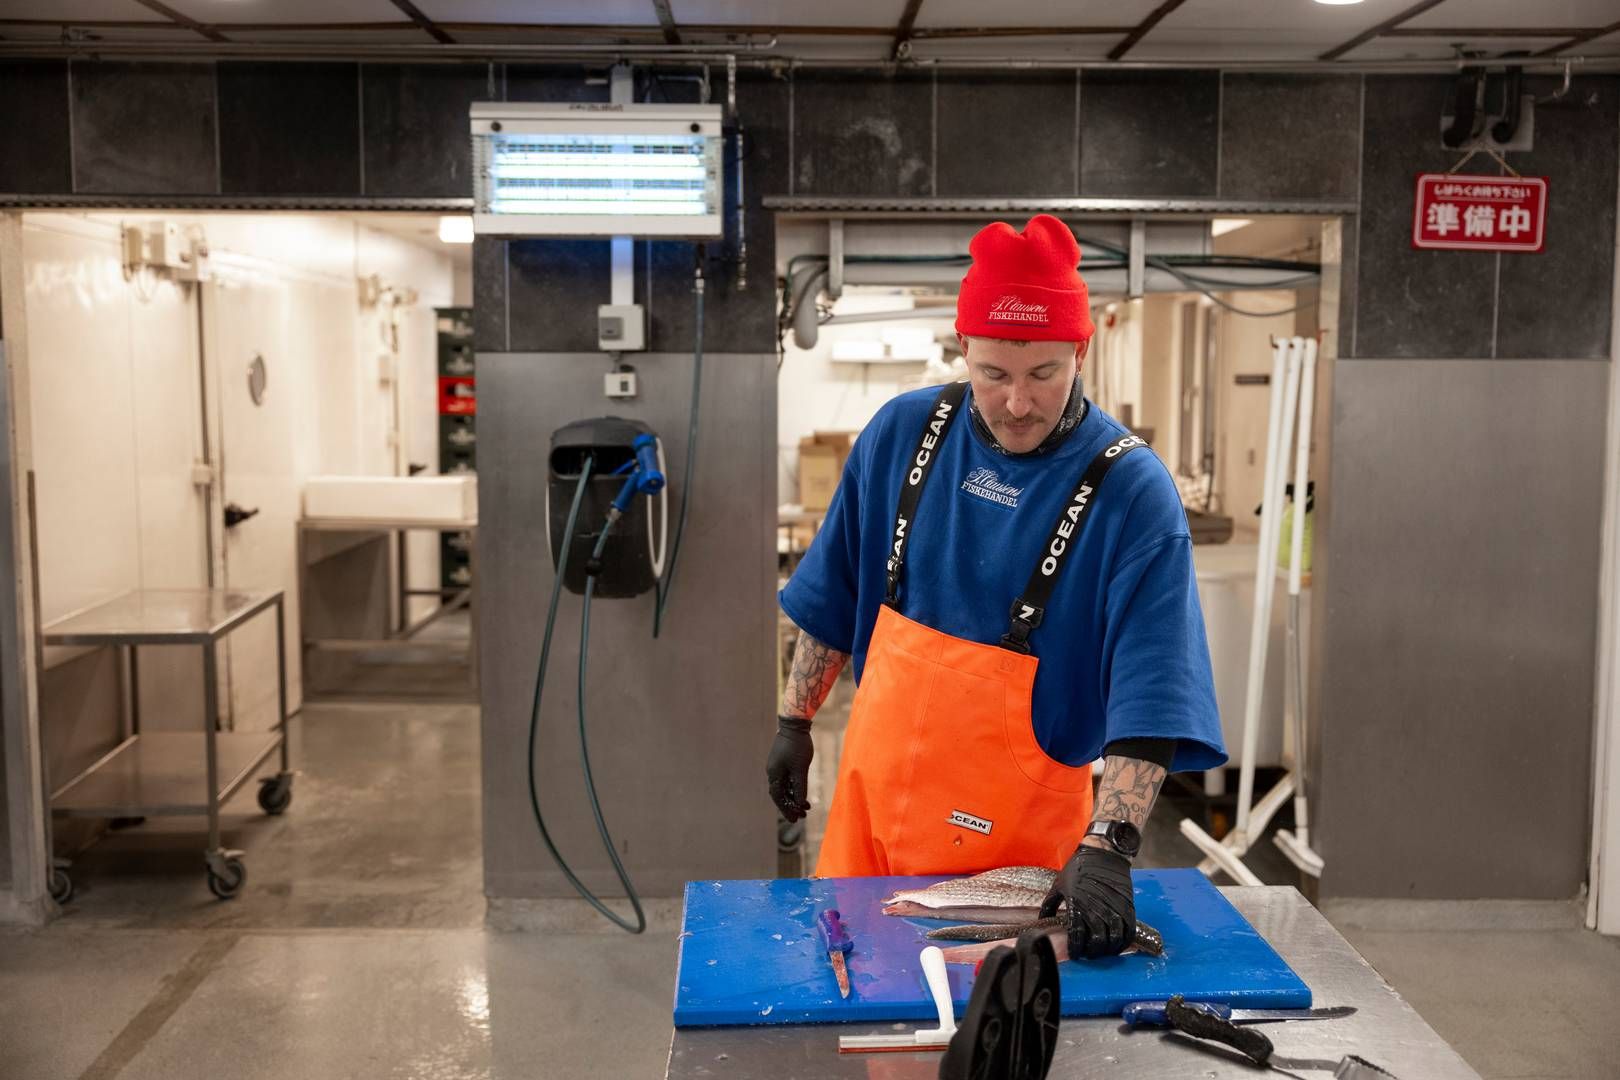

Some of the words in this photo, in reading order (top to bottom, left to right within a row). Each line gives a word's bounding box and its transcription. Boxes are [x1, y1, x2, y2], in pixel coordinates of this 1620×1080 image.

[1426, 203, 1531, 238] 準備中
[988, 311, 1049, 322] FISKEHANDEL
[909, 401, 953, 486] OCEAN
[1104, 435, 1148, 458] OCE
[960, 481, 1018, 508] FISKEHANDEL
[1041, 483, 1094, 576] OCEAN
